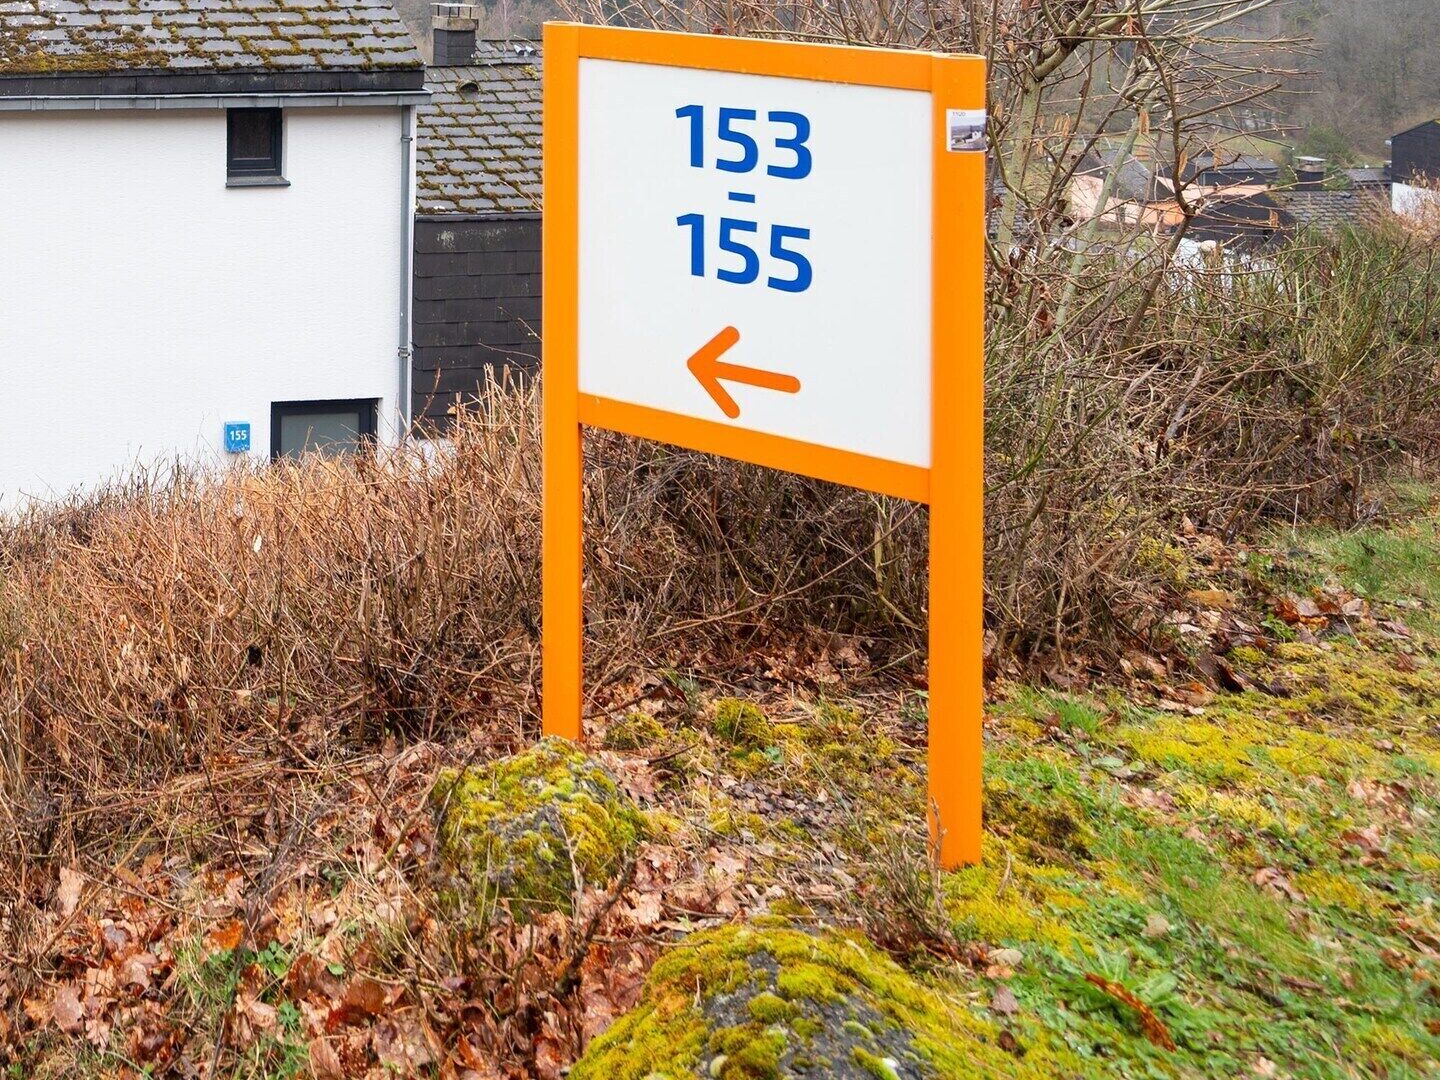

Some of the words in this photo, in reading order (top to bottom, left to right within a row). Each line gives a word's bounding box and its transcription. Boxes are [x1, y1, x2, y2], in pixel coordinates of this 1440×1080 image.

[676, 105, 812, 180] 153
[728, 192, 755, 203] -
[677, 213, 812, 292] 155
[230, 430, 247, 440] 155
